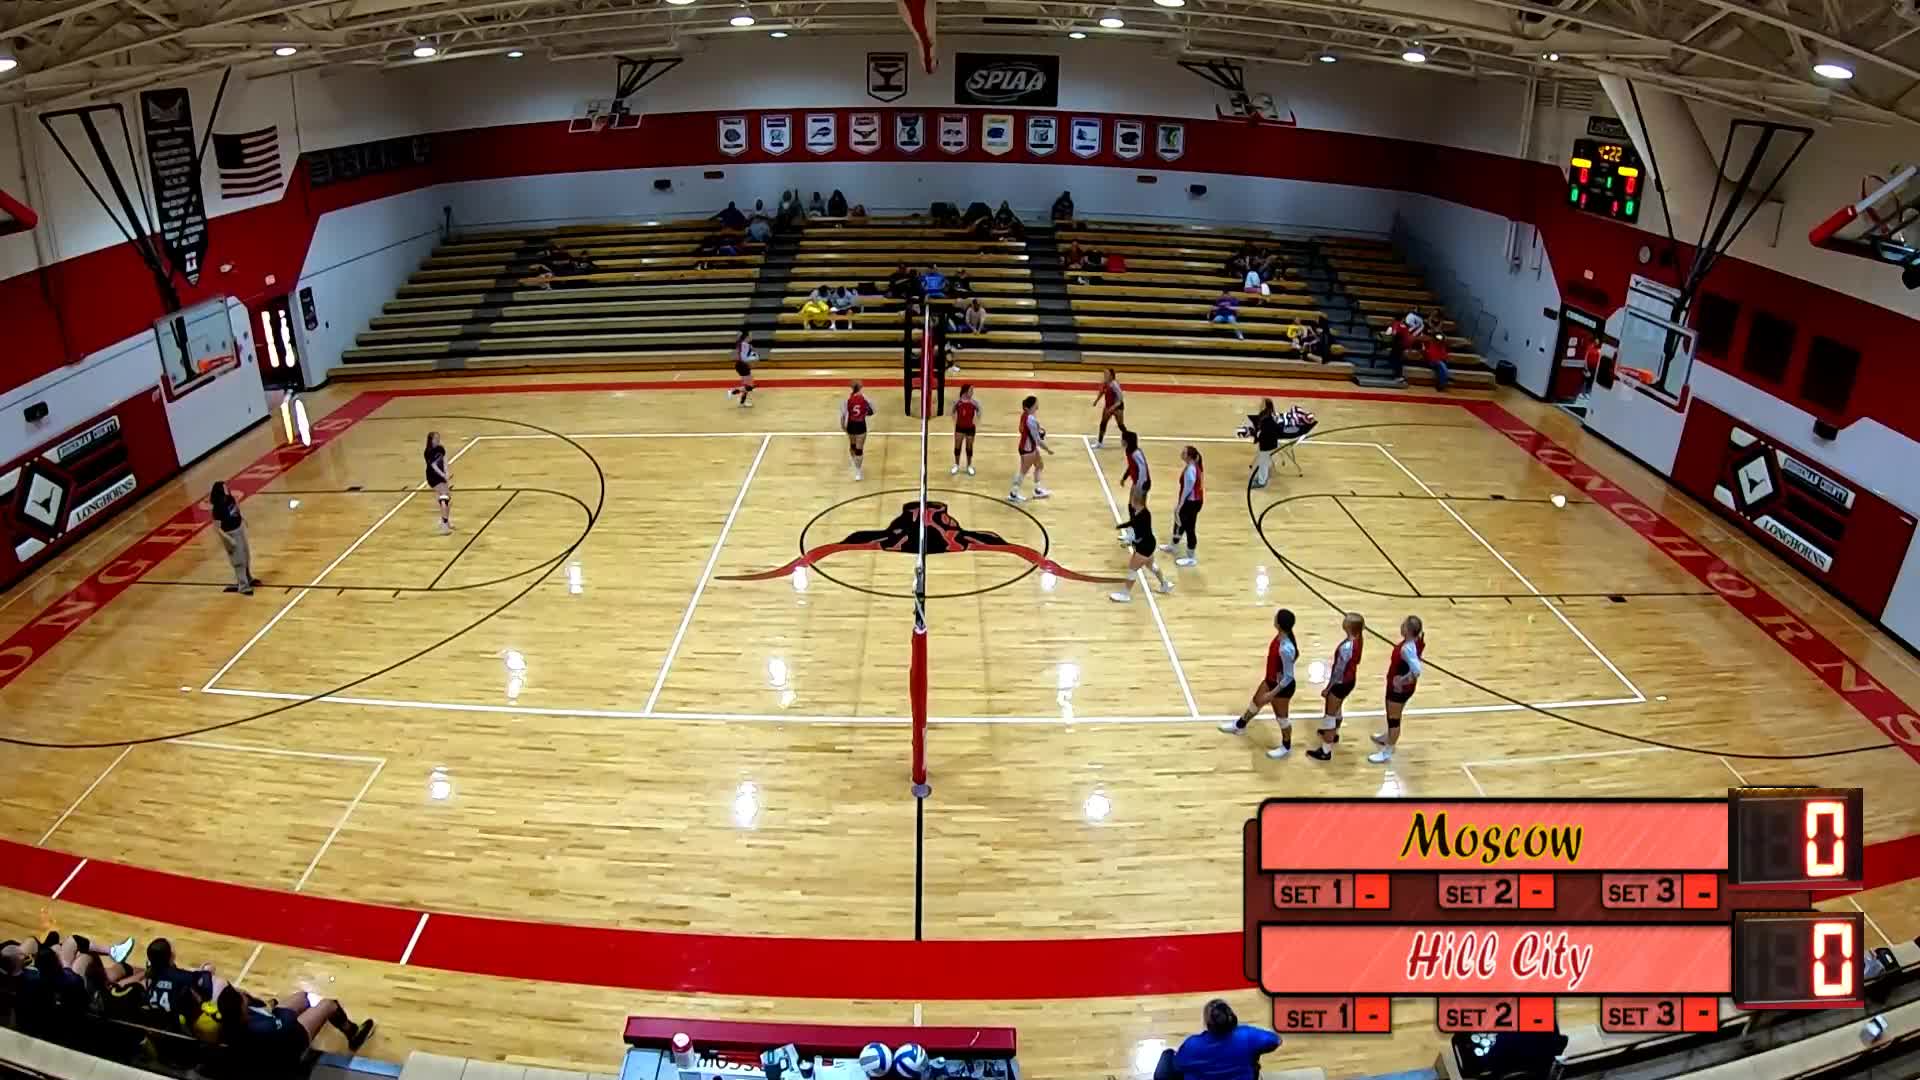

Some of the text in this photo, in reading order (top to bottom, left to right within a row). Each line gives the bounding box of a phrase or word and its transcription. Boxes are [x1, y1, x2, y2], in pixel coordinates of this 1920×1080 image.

[967, 70, 1046, 91] SPIAA
[76, 477, 134, 523] LONGHORNS
[1764, 519, 1827, 568] LONGHORNS
